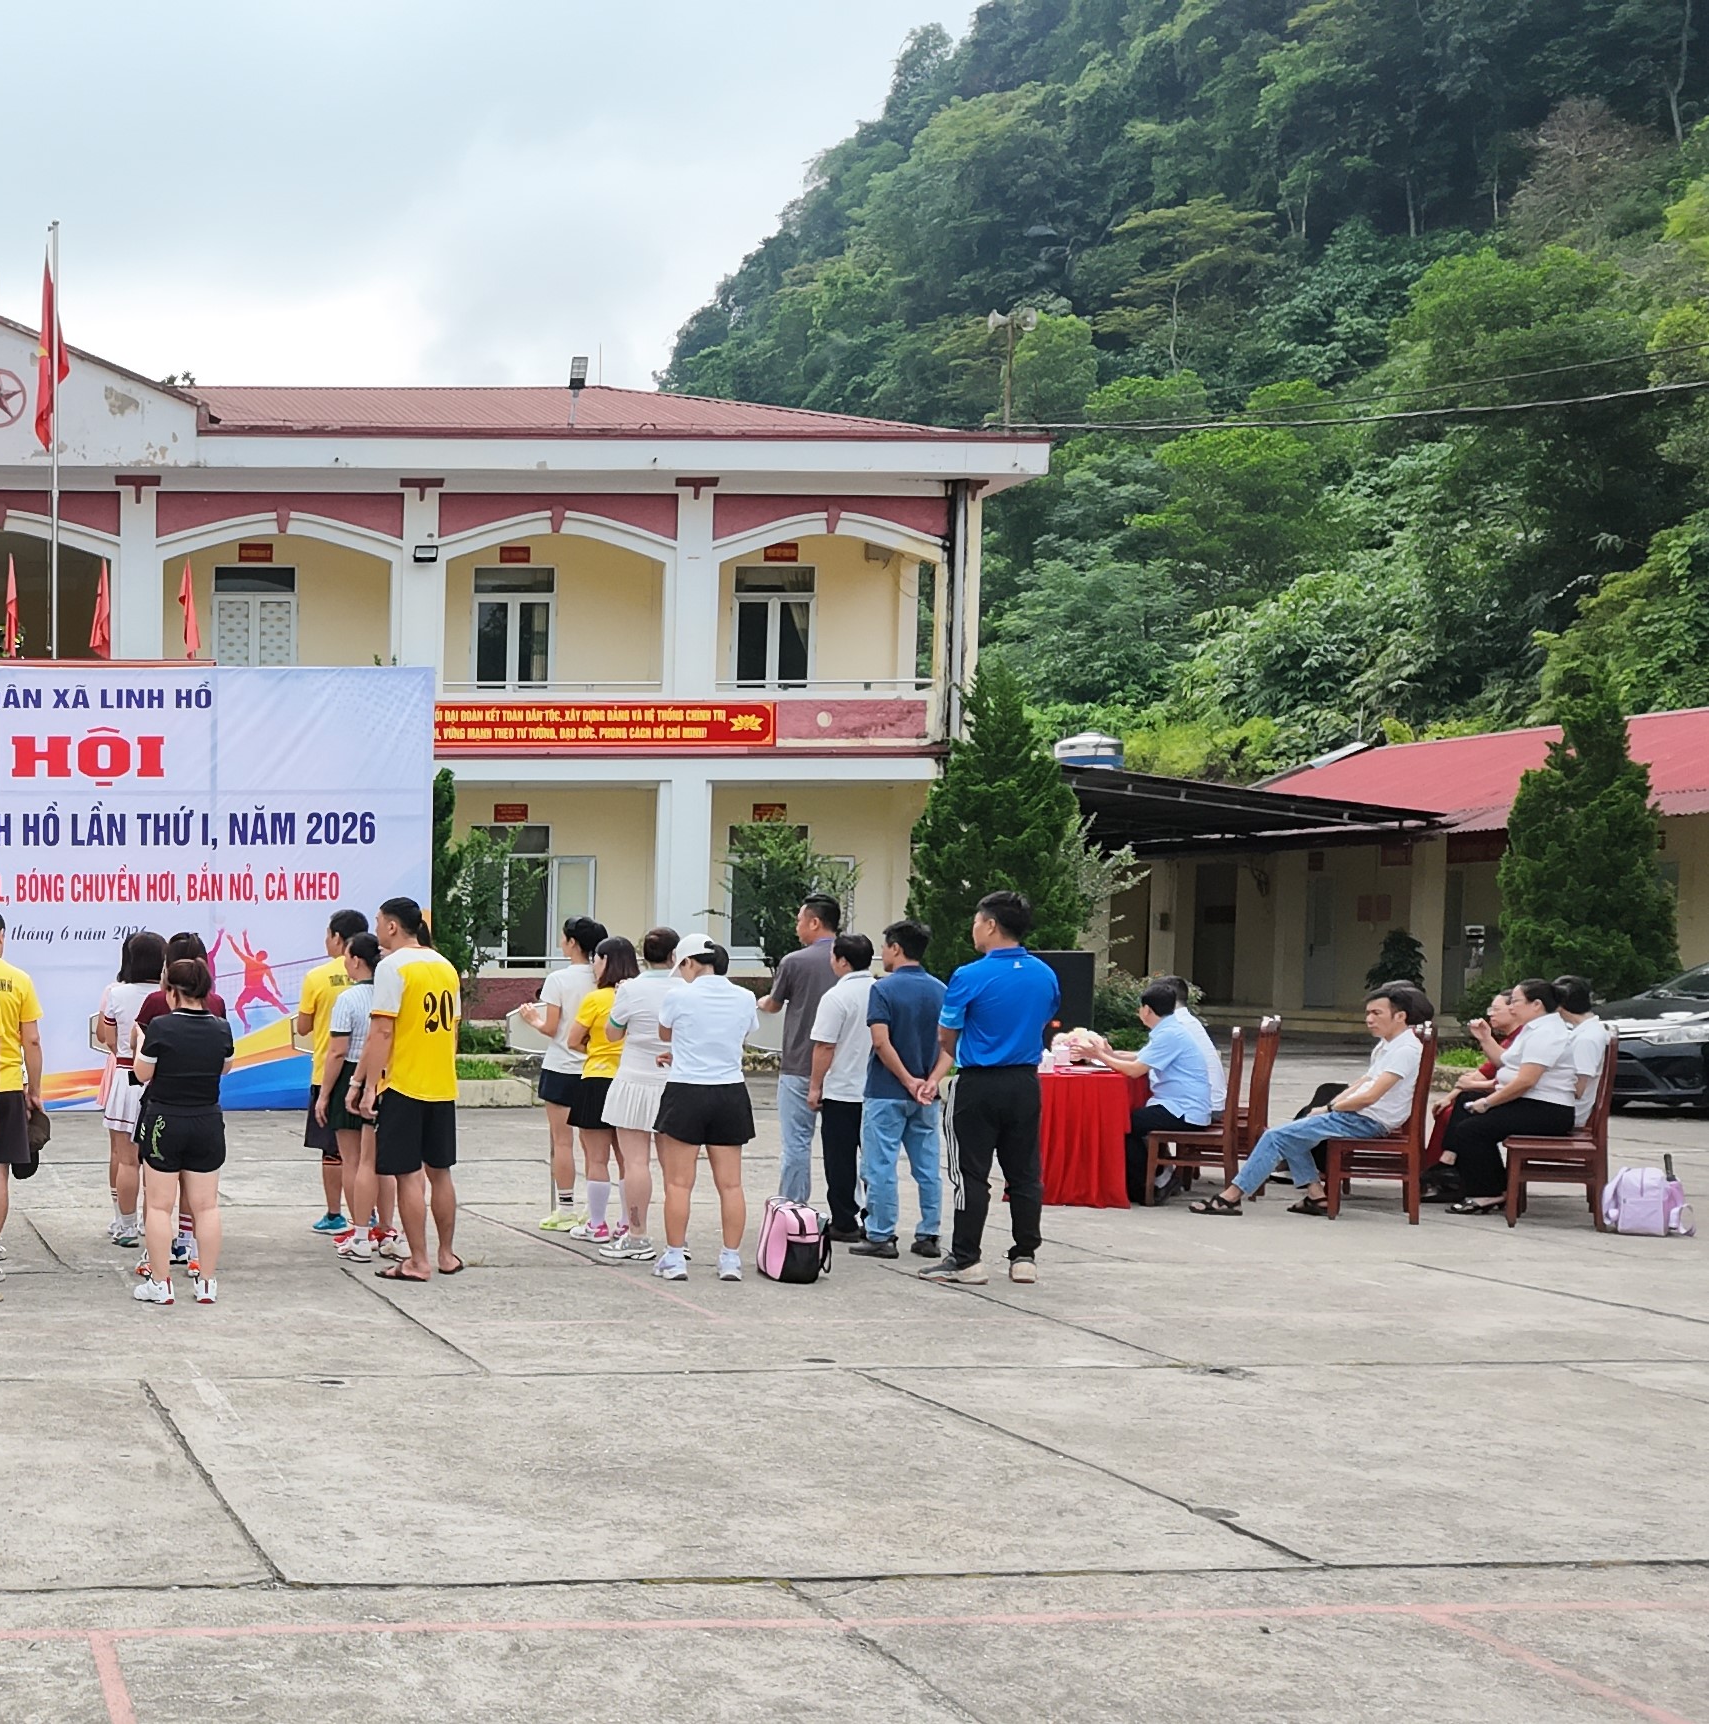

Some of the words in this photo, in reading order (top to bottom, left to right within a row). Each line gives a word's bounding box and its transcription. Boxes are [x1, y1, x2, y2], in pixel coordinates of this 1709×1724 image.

[52, 684, 91, 709] XÃ
[100, 687, 164, 709] LINH
[175, 680, 212, 709] HỒ
[485, 706, 501, 722] KẾT
[494, 727, 515, 740] THEO
[11, 726, 165, 787] HỘI
[22, 800, 60, 847] HỒ
[71, 800, 127, 847] LẦN
[136, 805, 194, 846] THỨ
[201, 813, 218, 851] I,
[228, 804, 296, 846] NĂM
[305, 811, 376, 845] 2026
[16, 867, 65, 903] BÓNG
[70, 863, 141, 903] CHUYỀN
[146, 871, 181, 906] HƠI,
[186, 862, 224, 902] BẮN
[229, 862, 259, 905] NỎ,
[264, 866, 288, 902] CÀ
[293, 871, 340, 902] KHEO
[10, 923, 55, 945] tháng
[60, 925, 69, 941] 6
[74, 927, 106, 941] năm
[423, 989, 454, 1034] 20
